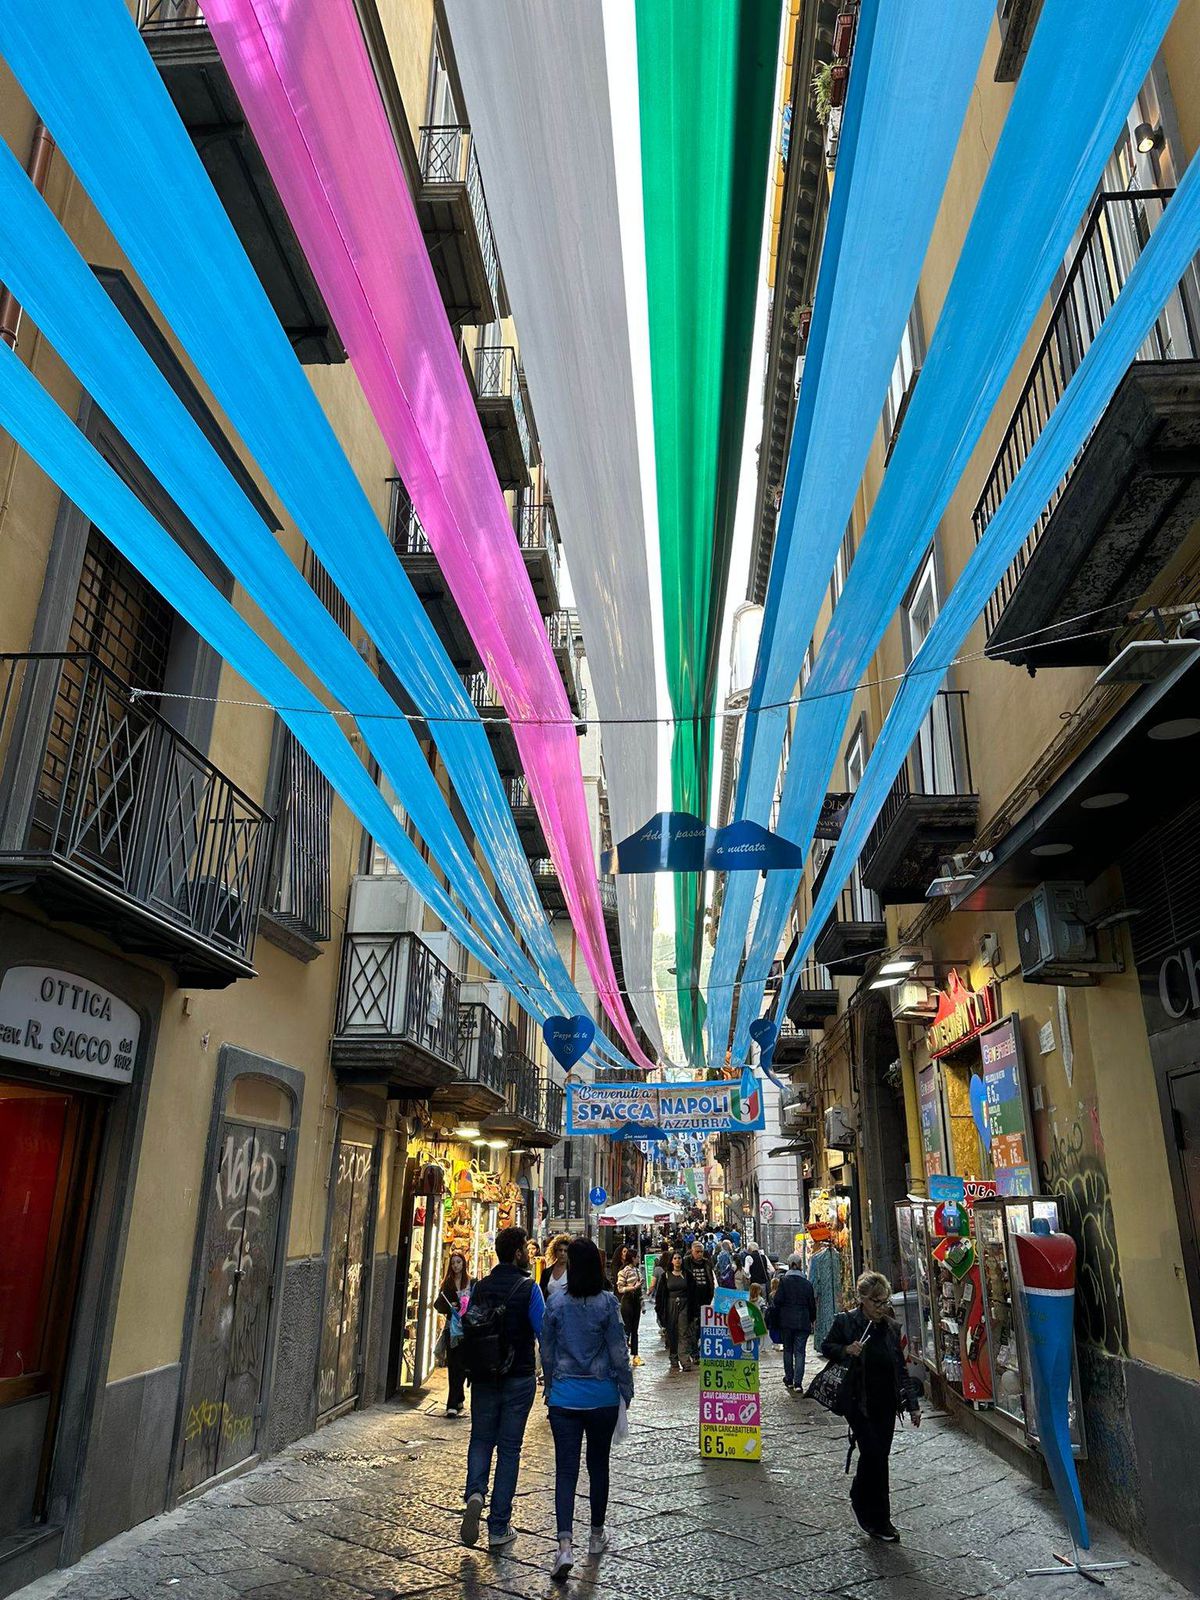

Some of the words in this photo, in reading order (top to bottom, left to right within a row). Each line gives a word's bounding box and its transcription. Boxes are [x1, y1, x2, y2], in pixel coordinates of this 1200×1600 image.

[716, 846, 724, 854] a
[727, 842, 767, 853] nuttata
[41, 976, 112, 1021] OTTICA
[24, 1019, 43, 1050] R.
[51, 1026, 111, 1065] SACCO
[573, 1031, 580, 1039] di
[581, 1031, 588, 1039] te
[578, 1085, 640, 1100] Benvenuti
[642, 1089, 651, 1099] a
[577, 1102, 656, 1121] SPACCA
[660, 1095, 728, 1115] NAPOLI
[662, 1117, 731, 1130] AZZURRA
[641, 1142, 647, 1151] 3
[691, 1143, 697, 1152] 3
[697, 1184, 704, 1194] 3
[703, 1339, 712, 1356] €
[703, 1370, 712, 1388] €
[703, 1402, 712, 1420] €
[703, 1424, 718, 1433] SPINA
[718, 1425, 758, 1434] CARICABATTERIA
[704, 1435, 713, 1454] €
